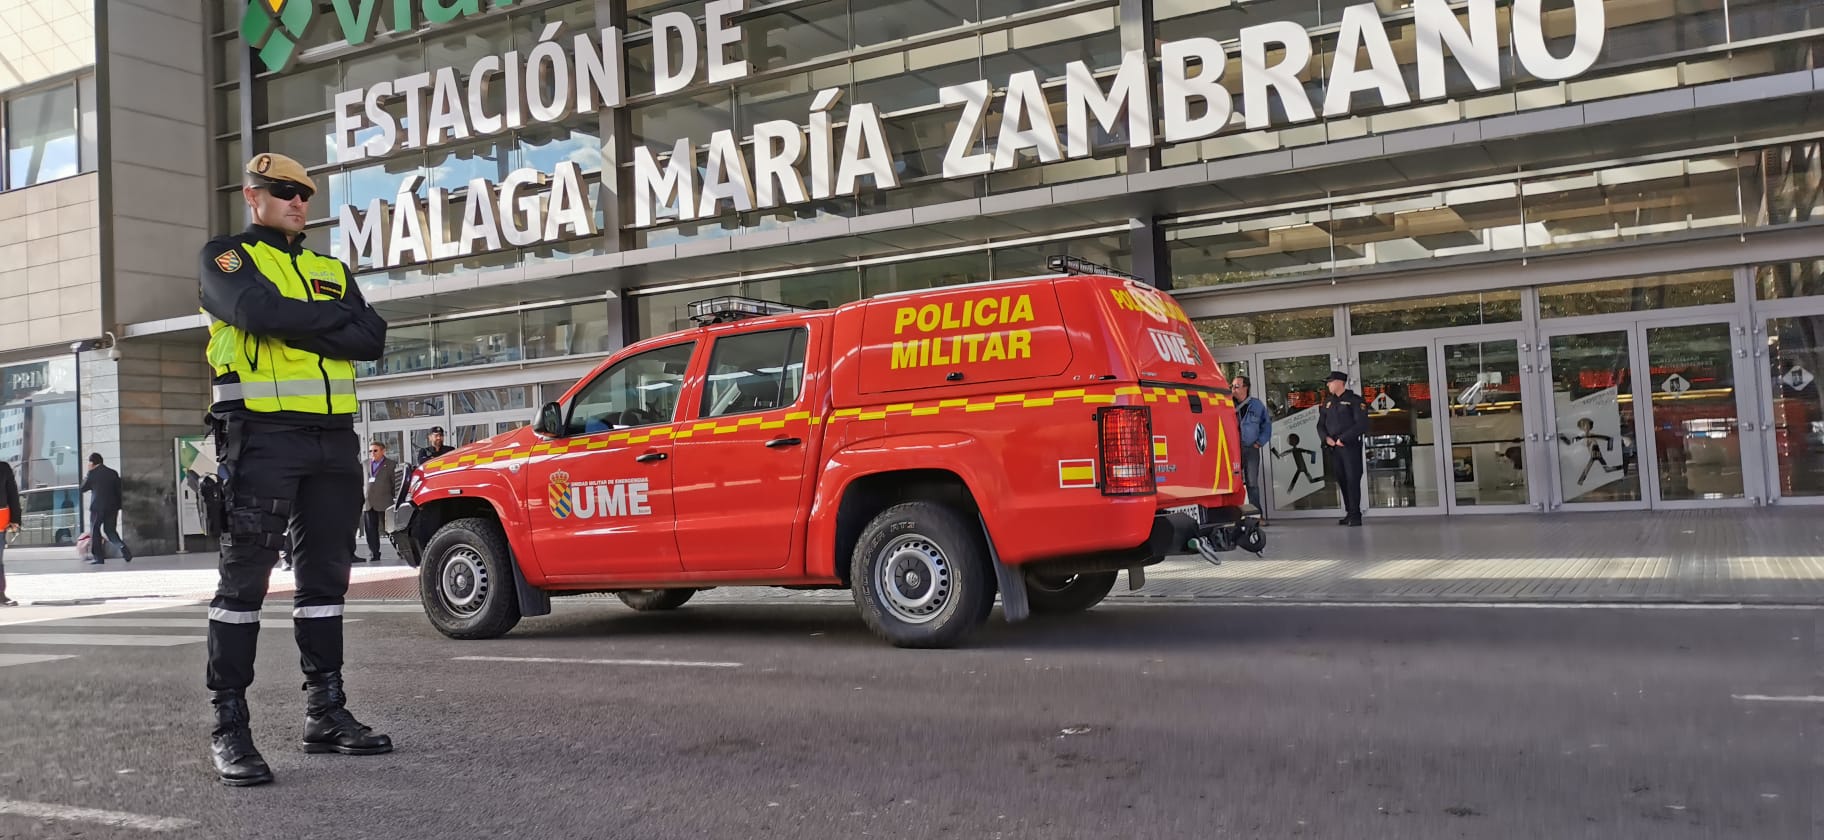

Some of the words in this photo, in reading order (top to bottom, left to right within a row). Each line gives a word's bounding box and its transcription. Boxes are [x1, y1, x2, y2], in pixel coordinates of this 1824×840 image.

[335, 21, 625, 163] ESTACIÓN
[652, 0, 750, 96] DE
[339, 160, 597, 272] MÁLAGA
[634, 87, 899, 227] MARÍA
[939, 0, 1605, 178] ZAMBRANO
[894, 294, 1035, 334] POLICIA
[890, 329, 1032, 370] MILITAR
[1149, 332, 1196, 366] UME
[572, 483, 651, 518] UME
